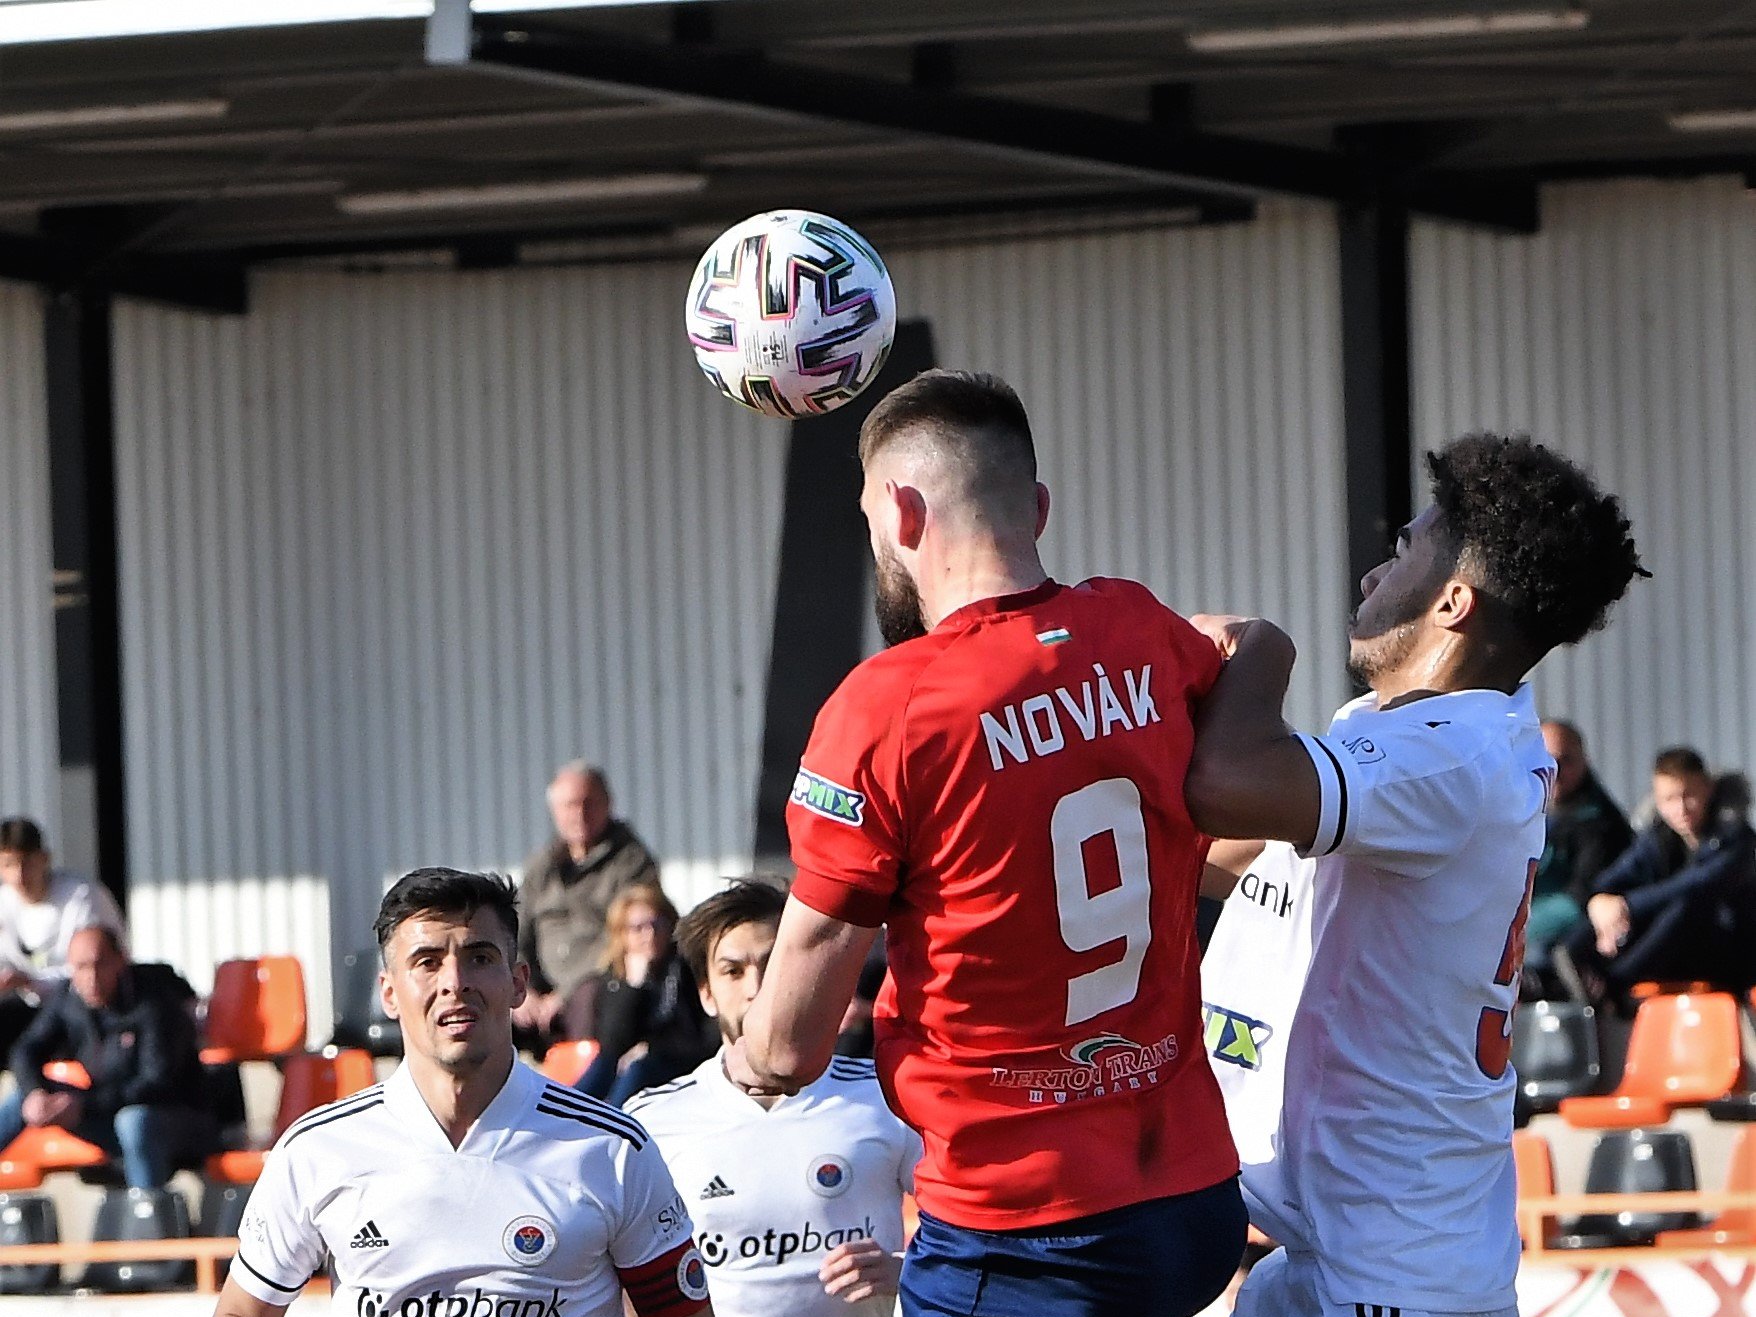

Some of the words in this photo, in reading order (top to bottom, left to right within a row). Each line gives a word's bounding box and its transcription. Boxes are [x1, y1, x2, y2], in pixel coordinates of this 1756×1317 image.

[979, 662, 1162, 771] NOVÀK
[1049, 776, 1151, 1027] 9
[1105, 1033, 1179, 1081] TRANS
